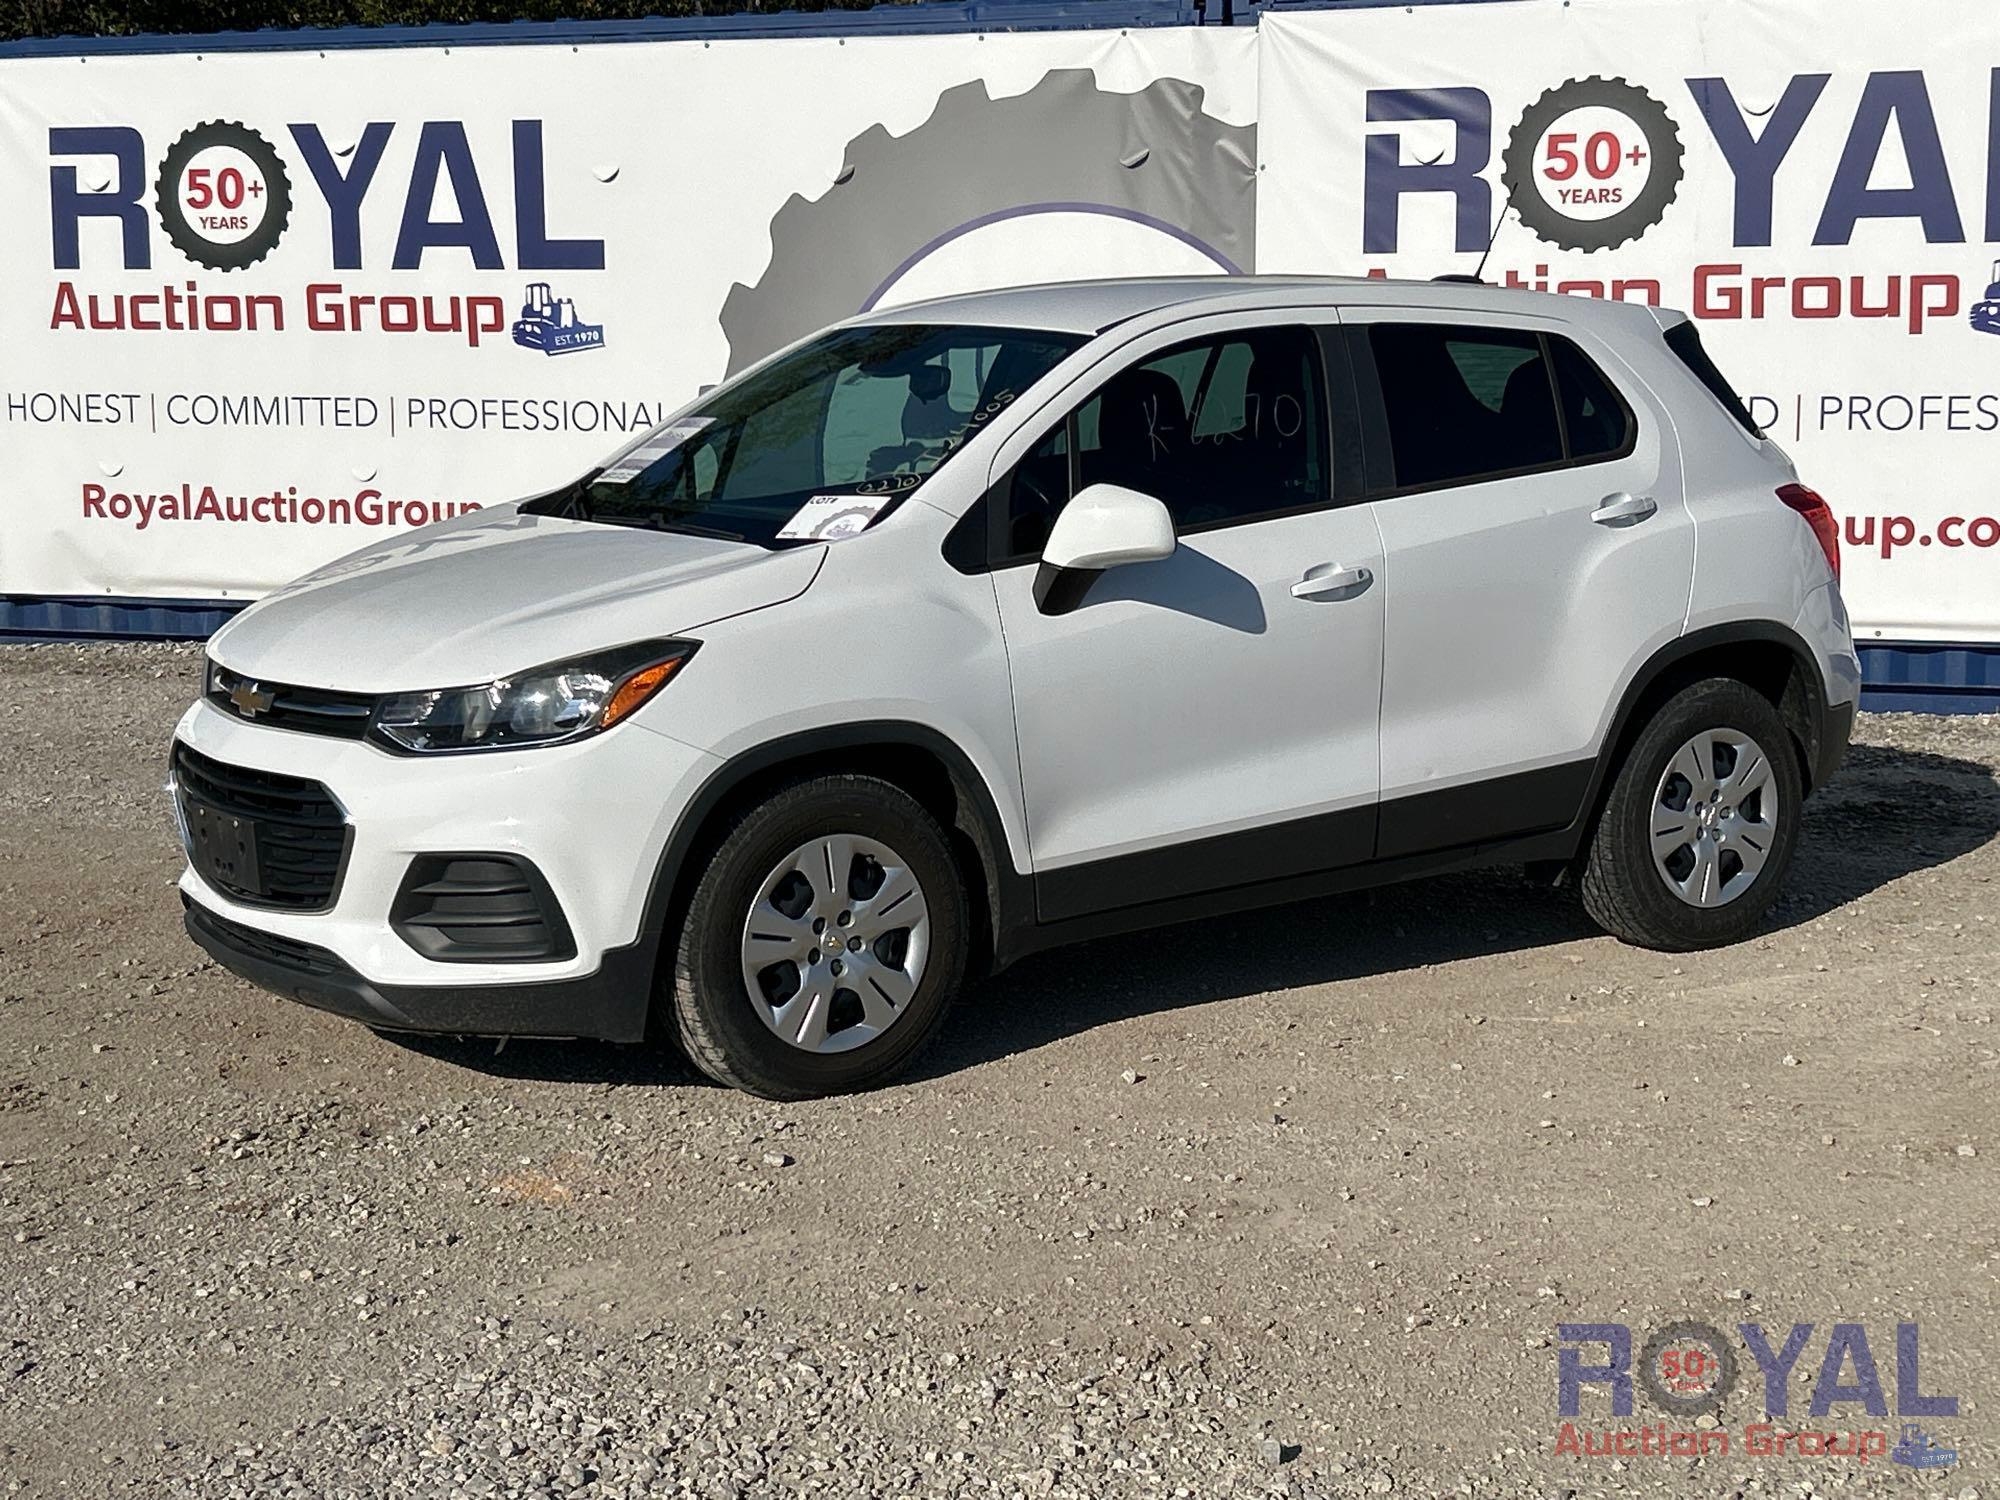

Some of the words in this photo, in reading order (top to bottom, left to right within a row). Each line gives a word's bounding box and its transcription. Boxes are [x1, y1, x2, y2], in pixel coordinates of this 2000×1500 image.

[1363, 67, 2000, 254] ROYA
[1543, 132, 1647, 181] 50+
[187, 168, 263, 209] 50+
[1558, 188, 1623, 204] YEARS
[199, 216, 248, 229] YEARS
[50, 281, 283, 332] Auction
[306, 284, 504, 347] Group
[1694, 264, 1960, 334] Group
[575, 331, 600, 342] 1970
[8, 393, 141, 424] HONEST
[167, 395, 377, 428] COMMITTED
